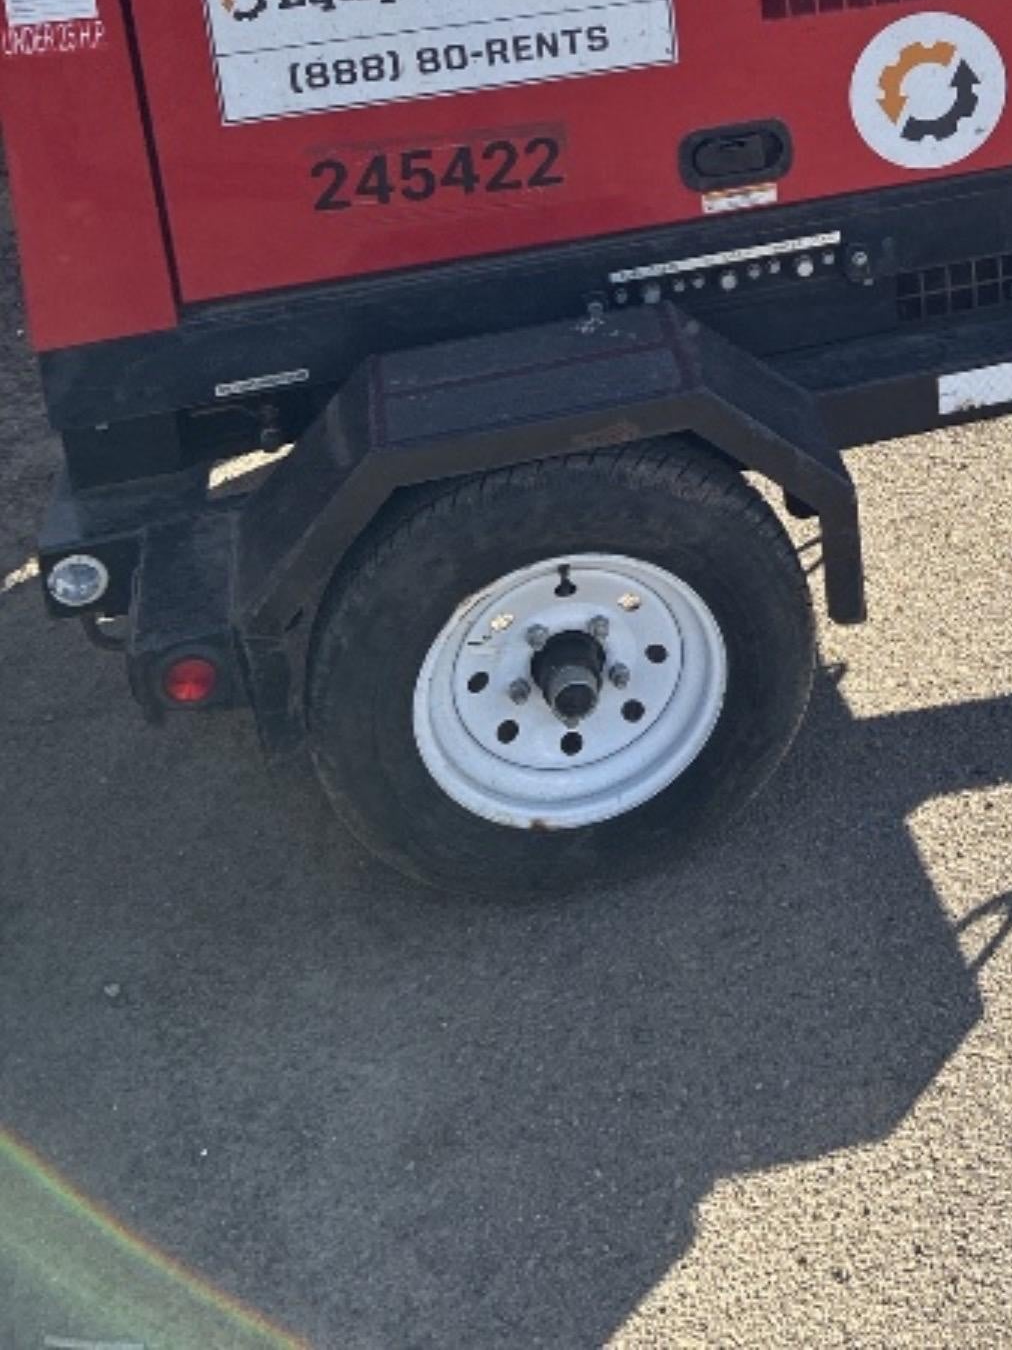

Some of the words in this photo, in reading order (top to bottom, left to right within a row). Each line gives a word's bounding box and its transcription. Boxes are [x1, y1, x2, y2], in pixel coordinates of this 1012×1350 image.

[289, 51, 400, 94] (888)
[416, 25, 610, 76] 80-RENTS
[310, 137, 564, 211] 245422
